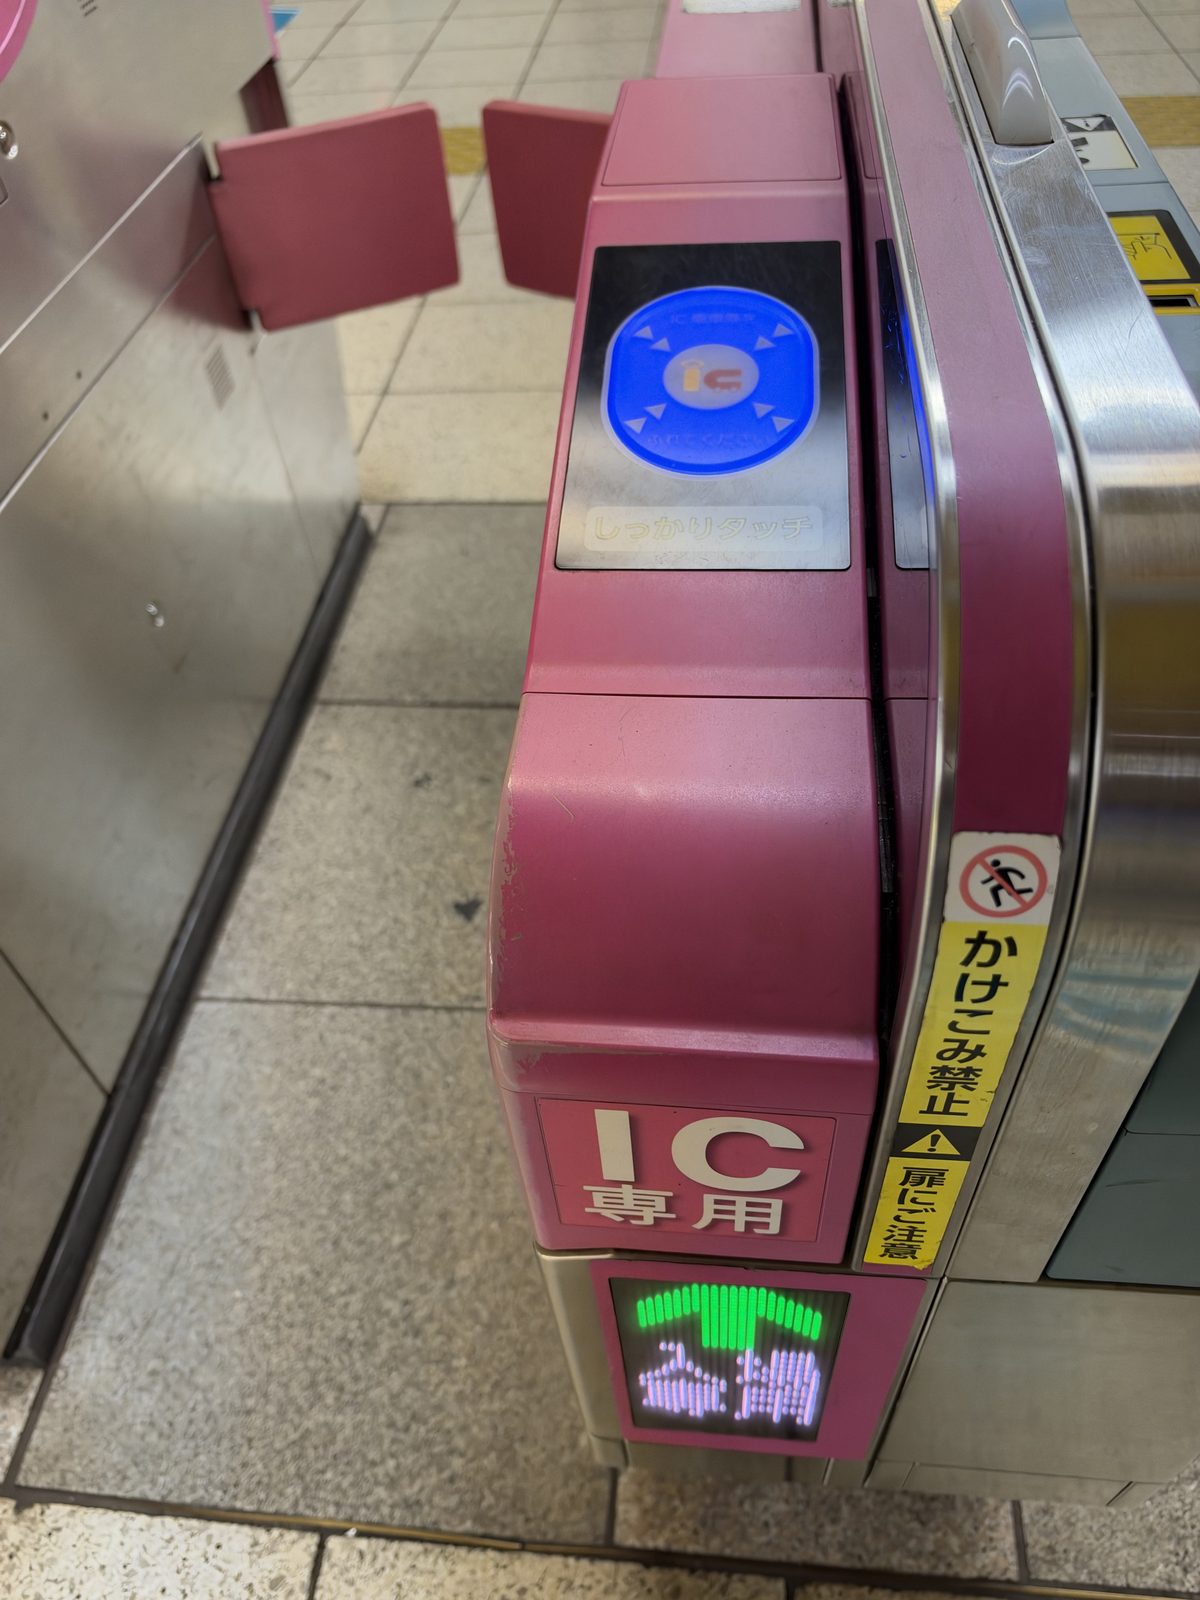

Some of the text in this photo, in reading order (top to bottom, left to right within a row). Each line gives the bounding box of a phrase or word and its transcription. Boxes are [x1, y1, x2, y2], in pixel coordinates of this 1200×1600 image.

[594, 516, 814, 541] しっかりタッチ
[919, 930, 1018, 1117] かけこみ禁止
[594, 1108, 805, 1192] IC
[583, 1184, 784, 1235] 専用
[878, 1166, 950, 1260] 扉にご注意
